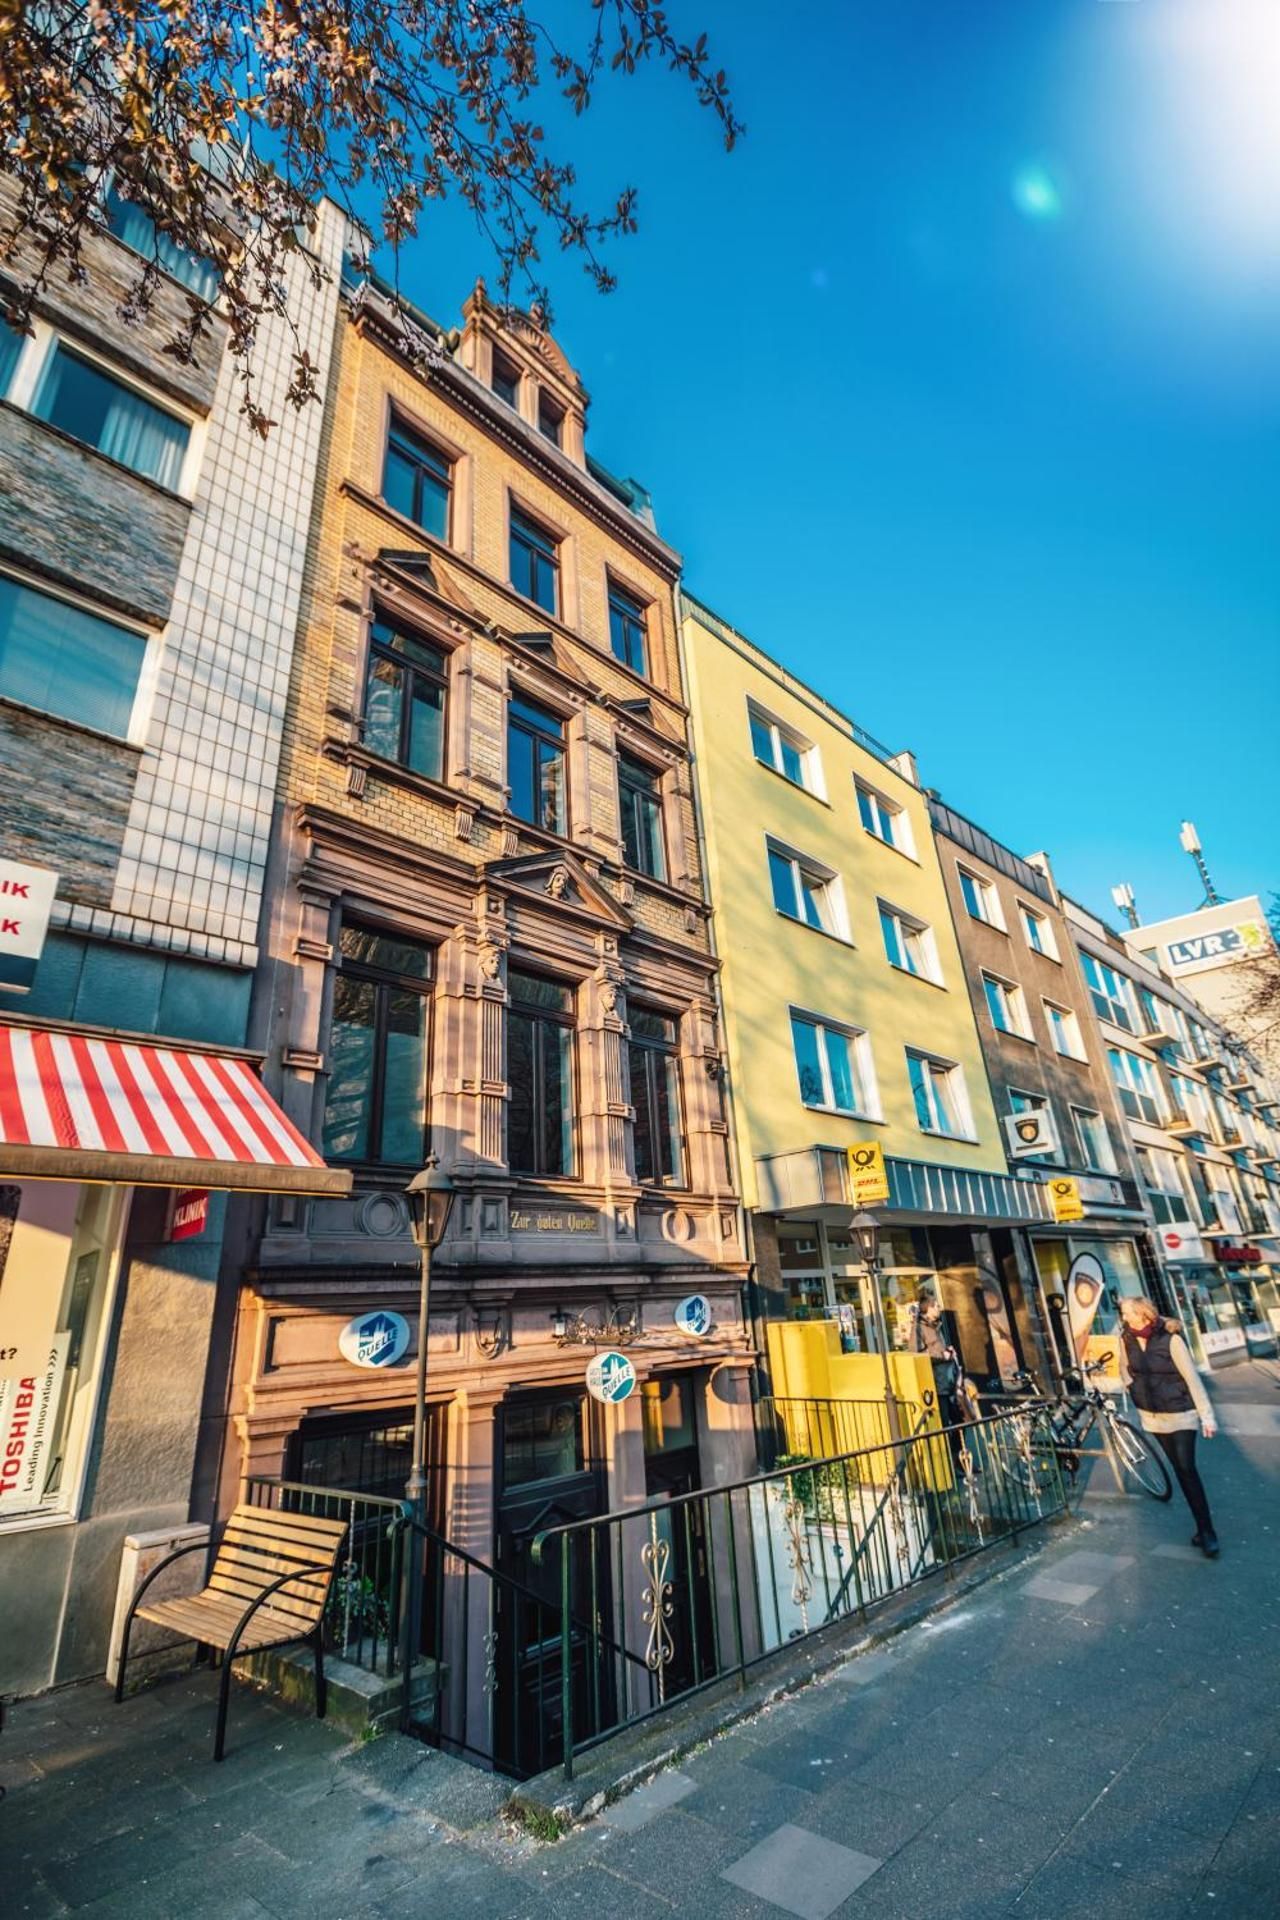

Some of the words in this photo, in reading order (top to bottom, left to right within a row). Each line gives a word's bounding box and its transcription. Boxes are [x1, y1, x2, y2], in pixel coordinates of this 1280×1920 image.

[1170, 936, 1227, 963] LVR
[173, 1196, 208, 1228] KLINIK
[510, 1211, 531, 1230] Zur
[357, 1327, 399, 1362] QUELLE
[602, 1366, 632, 1399] QUELLE
[0, 1377, 36, 1496] TOSHIBA
[23, 1440, 44, 1492] Leading
[34, 1371, 54, 1439] Innovation
